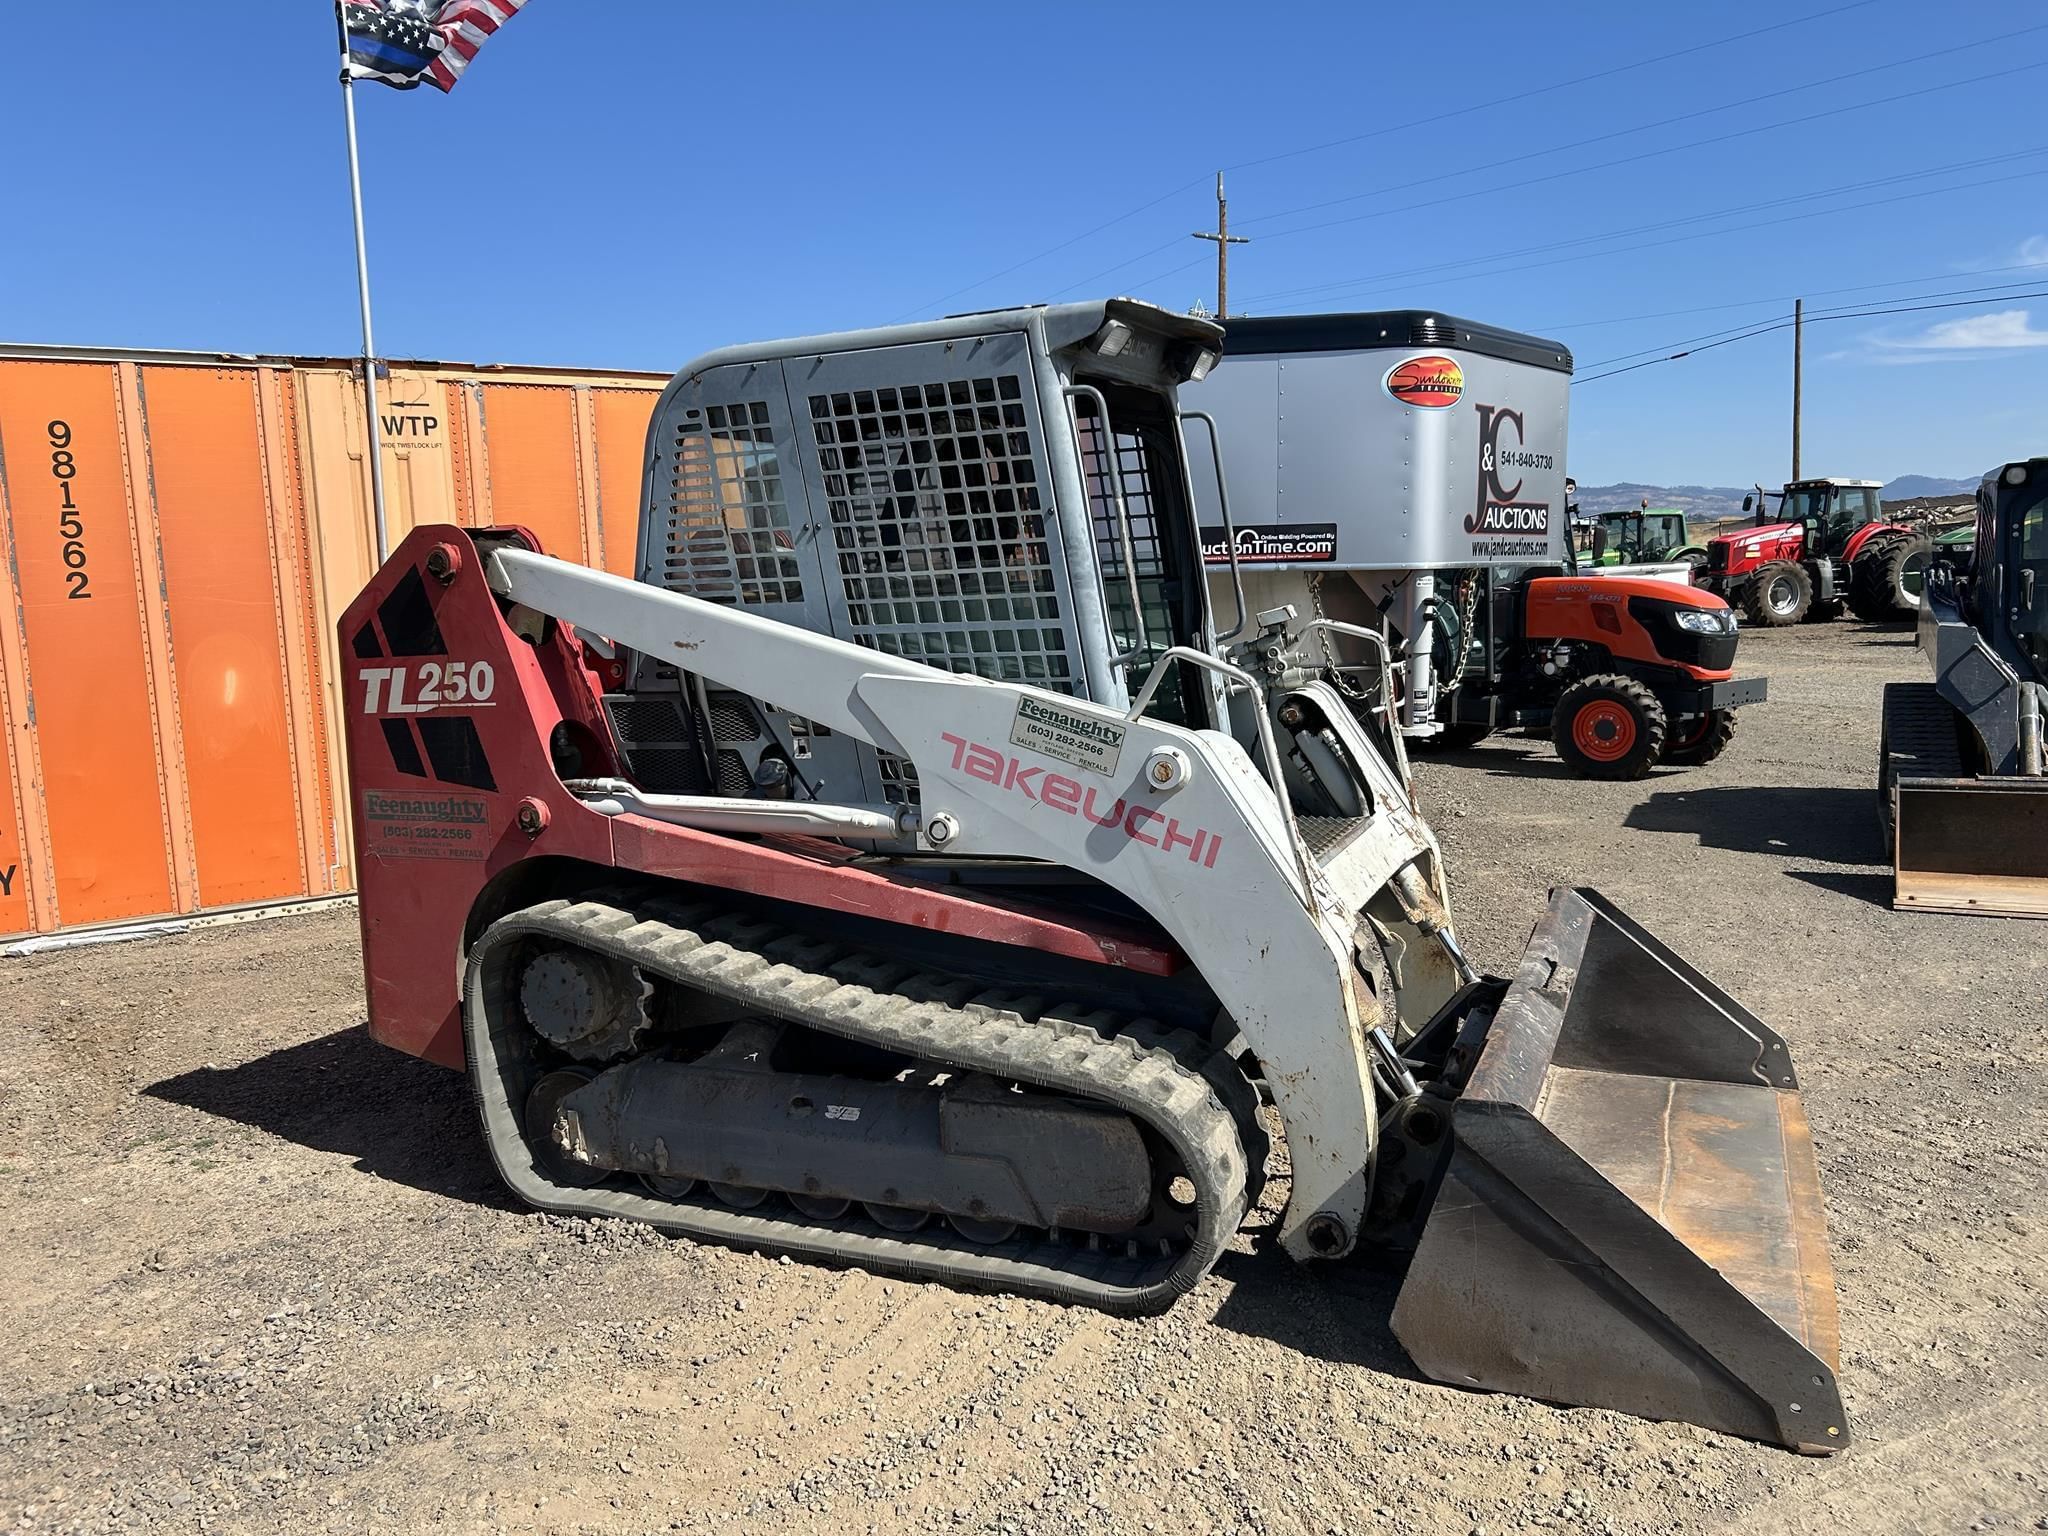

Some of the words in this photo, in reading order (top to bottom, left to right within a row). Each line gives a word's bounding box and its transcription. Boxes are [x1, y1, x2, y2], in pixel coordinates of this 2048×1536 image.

[381, 416, 438, 436] WTP
[1501, 451, 1553, 470] 541-840-3730
[47, 420, 92, 599] 981562
[1484, 507, 1547, 529] AUCTIONS
[1471, 536, 1548, 561] www.jandcauctions.com
[359, 661, 496, 713] TL250
[1020, 698, 1122, 743] Feenaughty
[1027, 723, 1054, 741] (503)
[1055, 733, 1104, 756] 282-2566
[1016, 737, 1036, 748] SALES
[1044, 746, 1071, 760] SERVICE
[1078, 758, 1108, 773] RENTALS
[367, 794, 486, 819] Feenaughty
[383, 825, 413, 840] (503)
[415, 827, 472, 840] 282-2566
